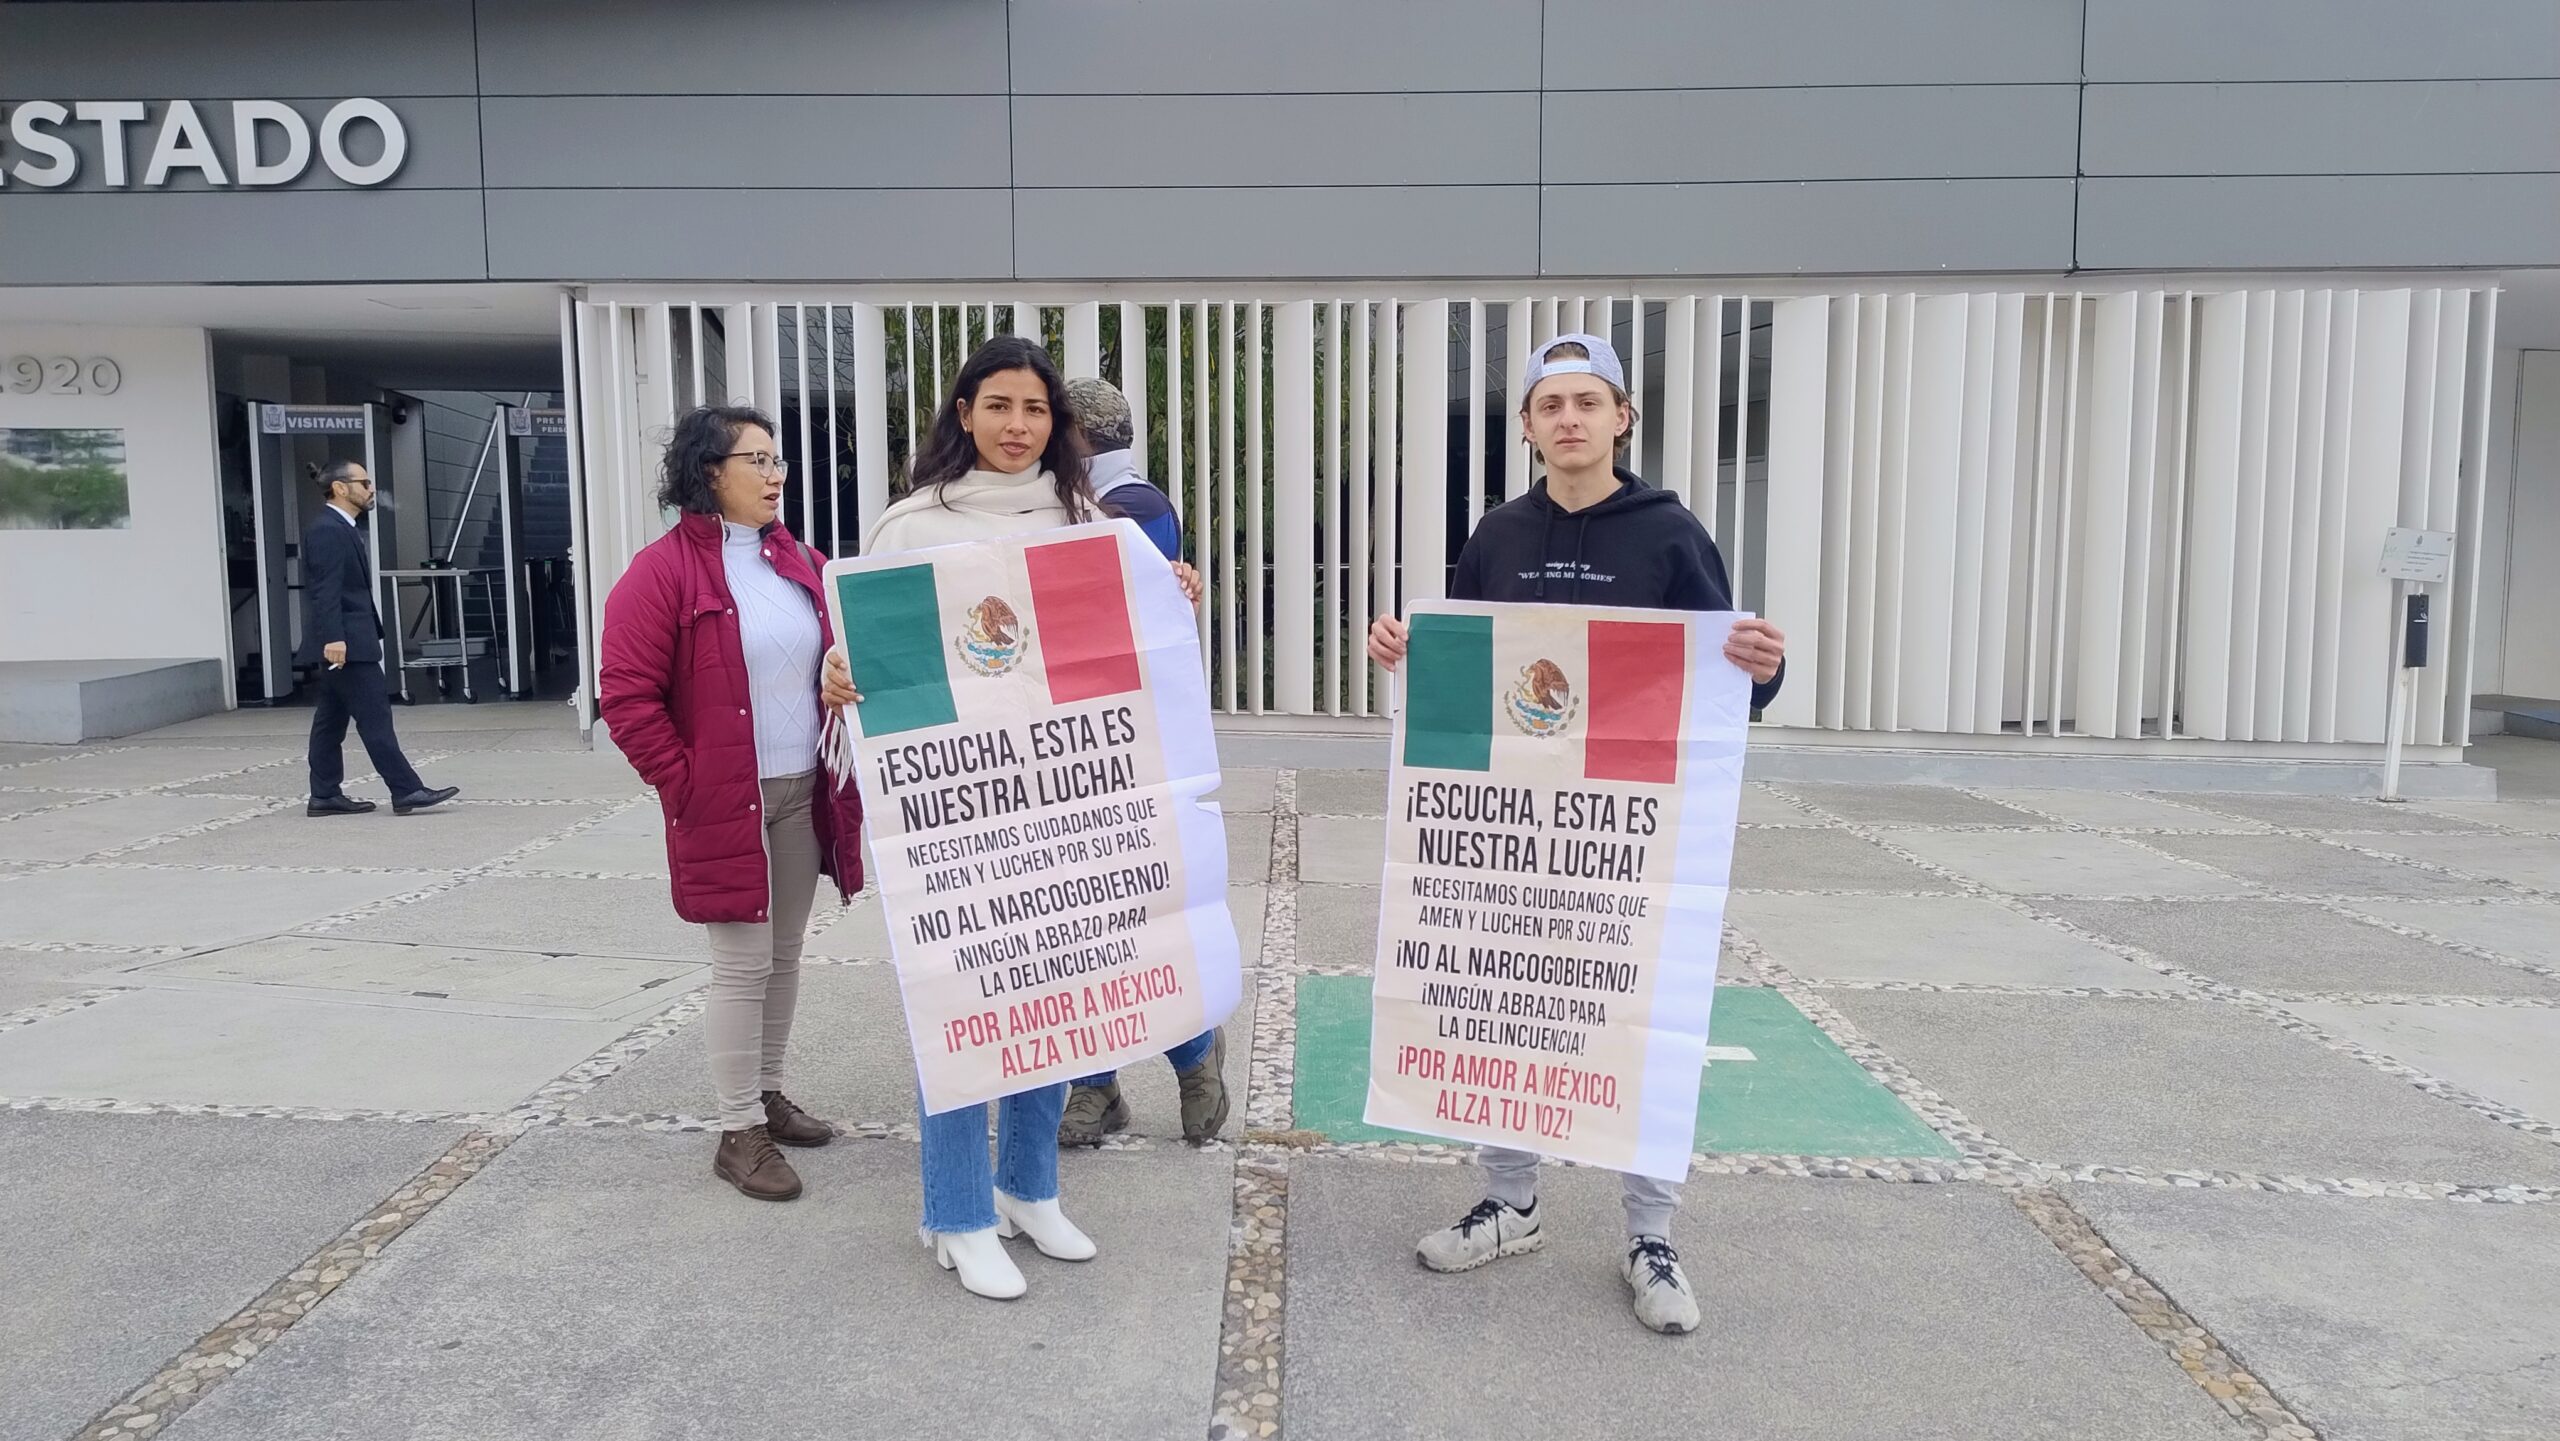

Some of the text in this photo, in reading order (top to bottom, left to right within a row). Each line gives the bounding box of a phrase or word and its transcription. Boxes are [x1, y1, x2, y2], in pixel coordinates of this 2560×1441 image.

[0, 97, 409, 187] STADO
[0, 355, 122, 397] 920
[287, 416, 364, 429] VISITANTE
[536, 417, 555, 425] PRE
[877, 706, 1136, 795] ¡ESCUCHA, ESTA ES
[900, 753, 1136, 833] NUESTRA LUCHA!
[1407, 781, 1658, 836] ¡ESCUCHA, ESTA ES
[907, 798, 1158, 868] NECESITAMOS CIUDADANOS QUE
[925, 825, 1157, 895] AMEN Y LUCHEN POR SU PAÍS.
[1418, 828, 1645, 882] NUESTRA LUCHA!
[910, 860, 1171, 945] ¡NO AL NARCOGOBIERNO!
[1412, 876, 1649, 917] NECESITAMOS CIUDADANOS QUE
[953, 905, 1147, 973] ¡NINGÚN ABRAZO PARA
[1418, 906, 1634, 947] AMEN Y LUCHEN POR SU PAÍS.
[980, 937, 1139, 998] LA DELINCUENCIA!
[1396, 940, 1638, 994] ¡NO AL NARCOGOBIERNO!
[943, 964, 1183, 1054] ¡POR AMOR A MÉXICO,
[1421, 982, 1606, 1027] ¡NINGÚN ABRAZO PARA
[1000, 1011, 1148, 1079] ALZA TU VOZ!
[1438, 1015, 1586, 1056] LA DELINCUENCIA!
[1398, 1046, 1621, 1114] ¡POR AMOR A MÉXICO,
[1436, 1089, 1491, 1126] ALZA
[1499, 1098, 1527, 1131] TU
